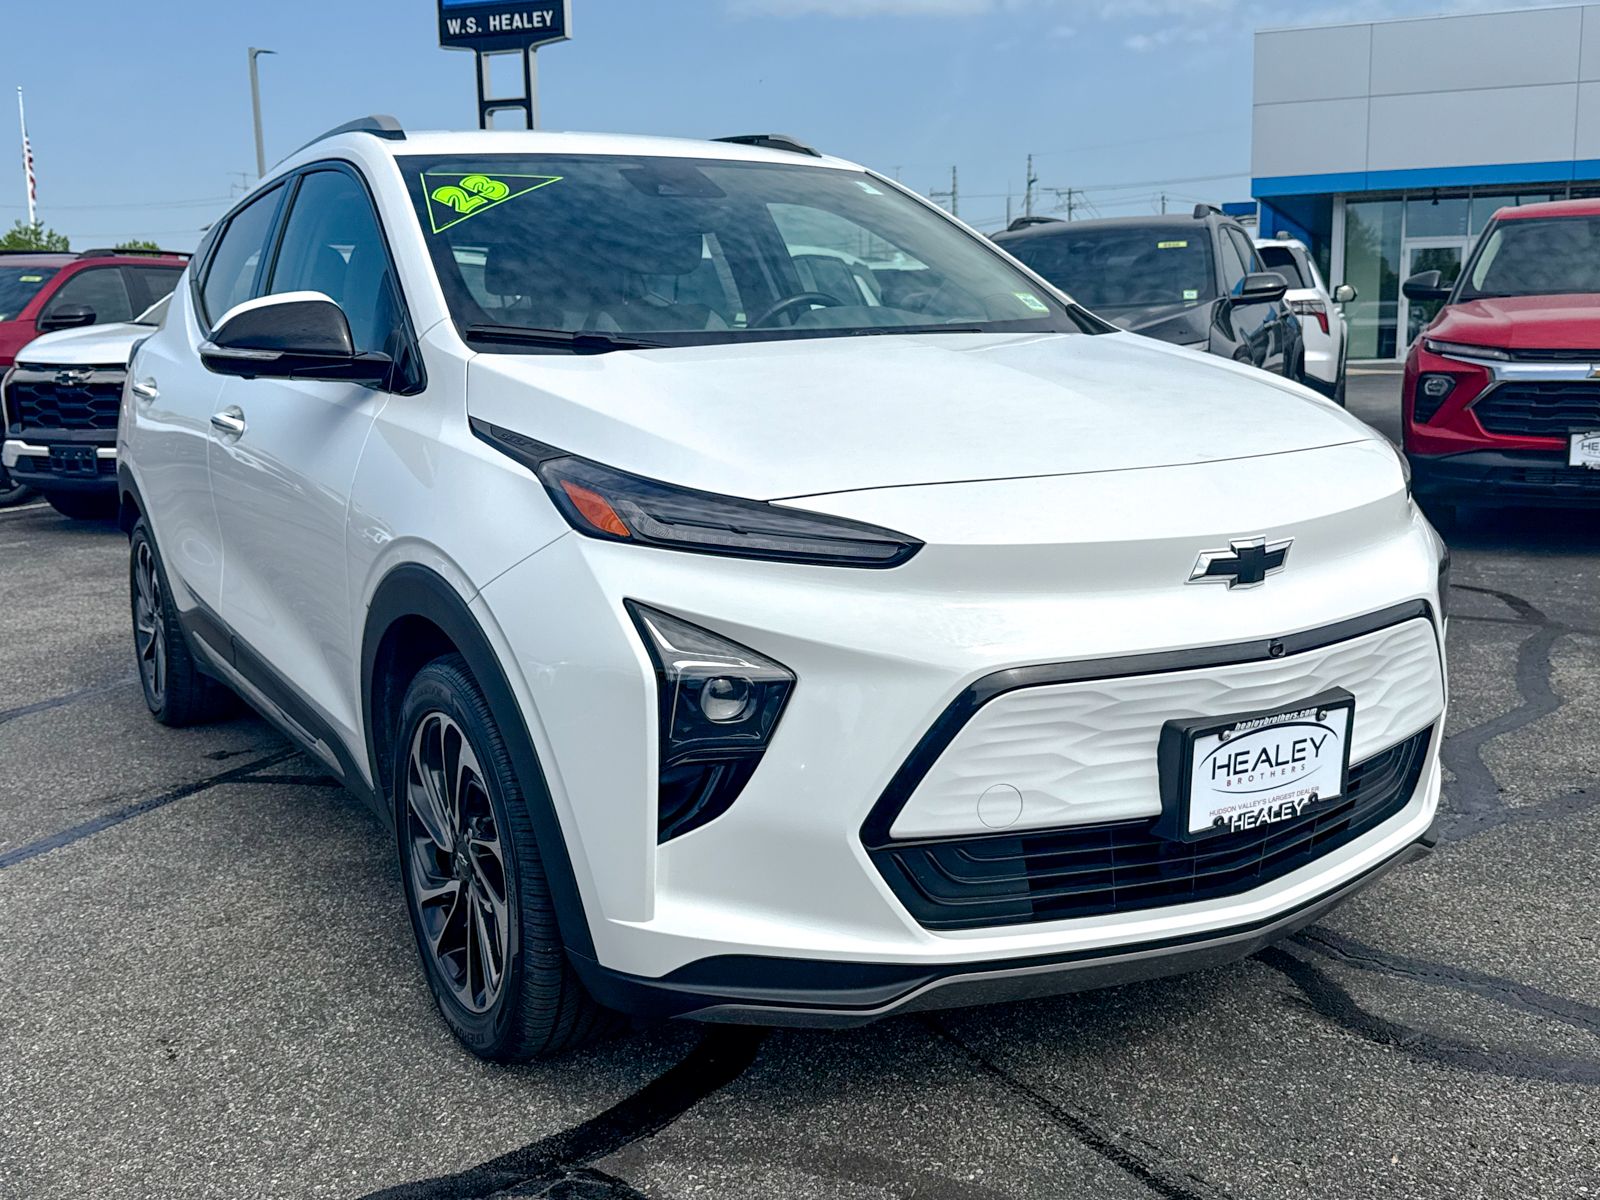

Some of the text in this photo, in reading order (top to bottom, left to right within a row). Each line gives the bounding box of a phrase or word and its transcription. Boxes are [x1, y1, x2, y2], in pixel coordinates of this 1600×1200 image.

[447, 10, 553, 35] W.S. HEALEY
[431, 175, 510, 214] 23
[1234, 708, 1318, 732] healeybrothers.com
[1211, 733, 1328, 780] HEALEY
[1226, 763, 1306, 787] BROTHERS
[1209, 785, 1320, 817] HUDSON VALLEY'S LARGEST DEALER
[1231, 799, 1306, 833] HEALEY
